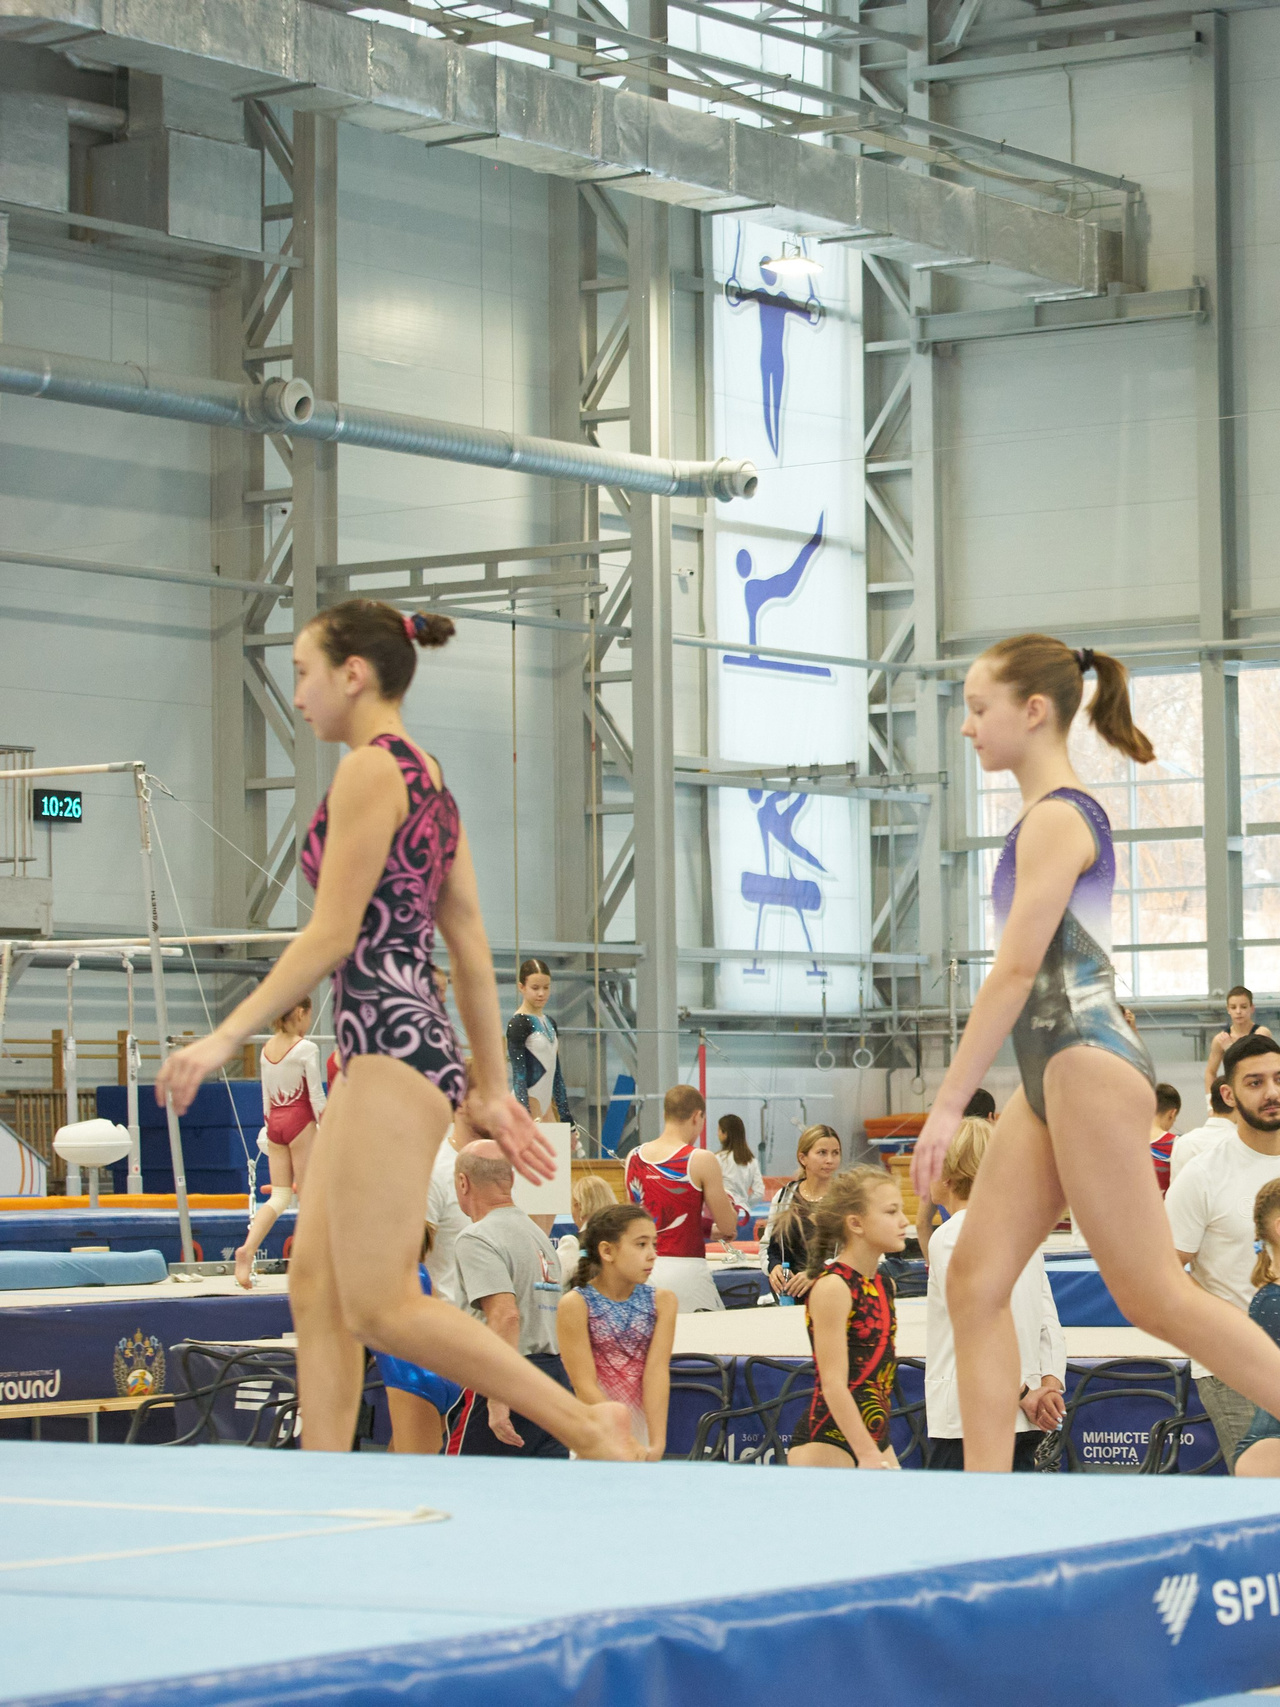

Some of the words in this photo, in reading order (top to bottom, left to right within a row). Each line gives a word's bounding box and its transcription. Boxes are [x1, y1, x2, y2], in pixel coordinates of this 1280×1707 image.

[41, 795, 82, 818] 10:26
[1083, 1431, 1195, 1446] МИНИСТЕТВО
[1083, 1446, 1138, 1459] СПОРТА
